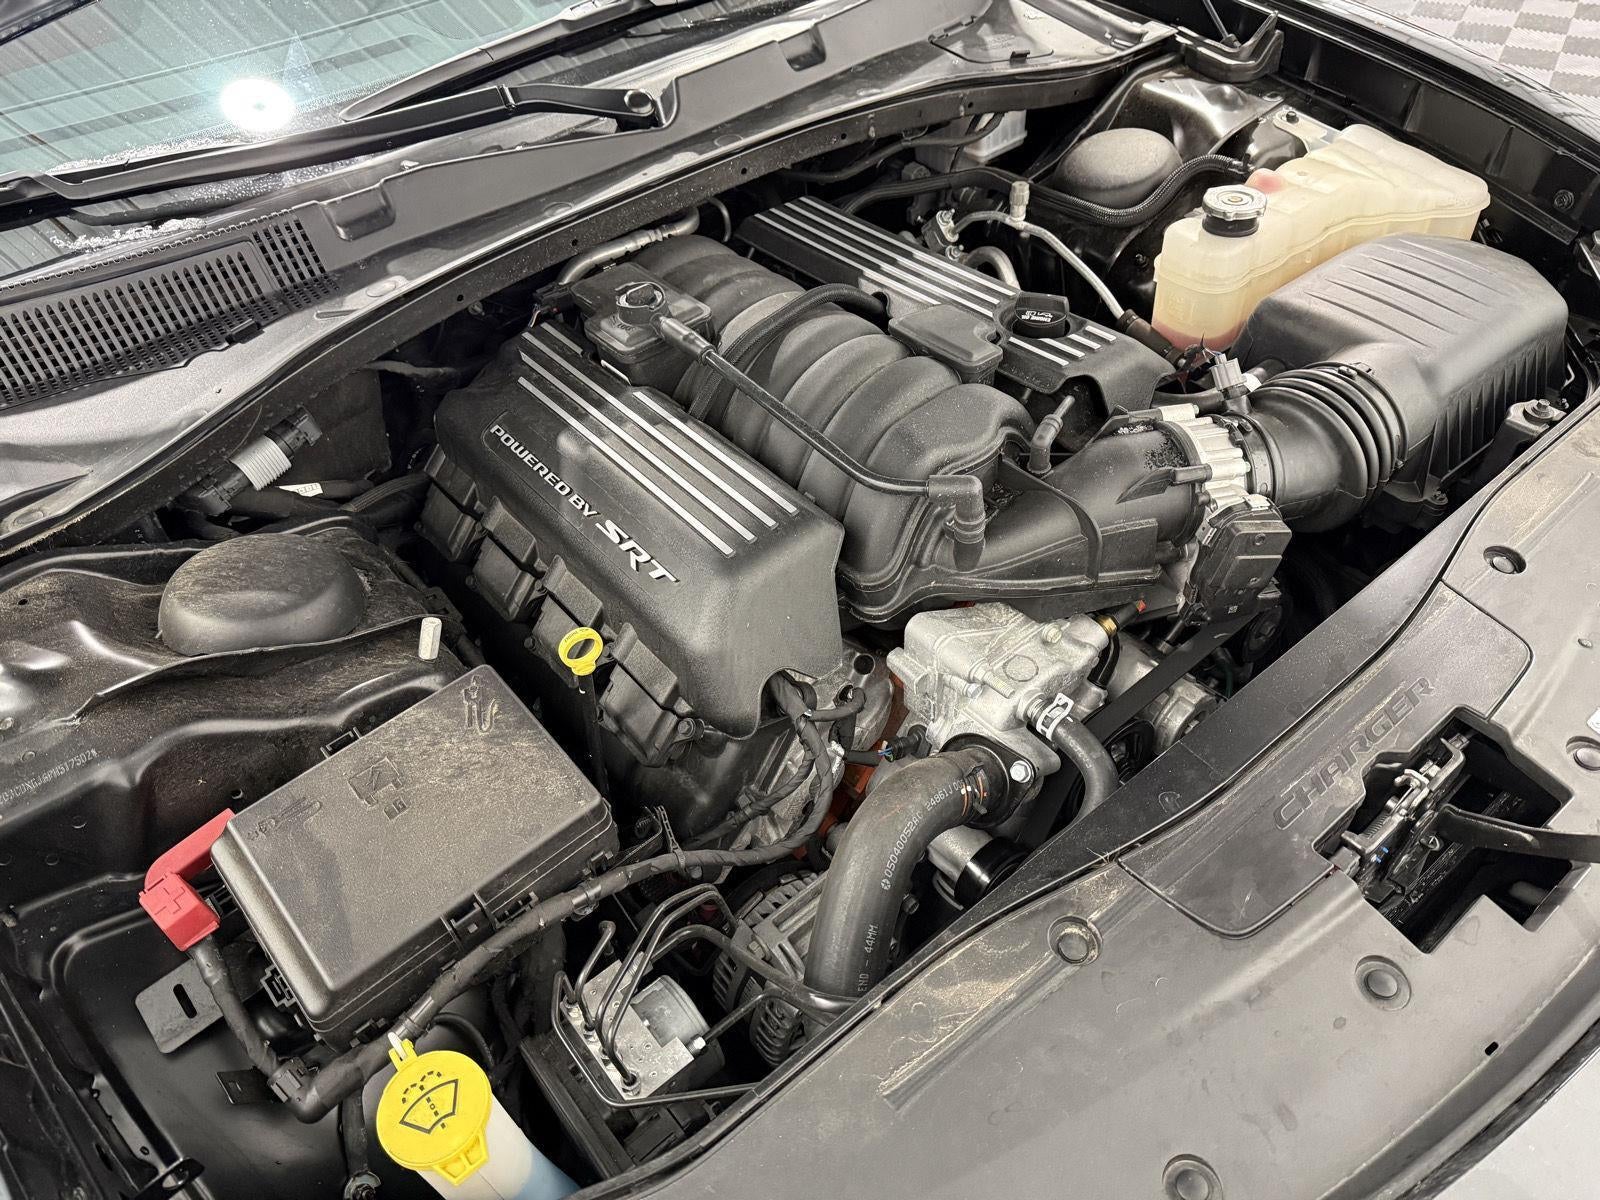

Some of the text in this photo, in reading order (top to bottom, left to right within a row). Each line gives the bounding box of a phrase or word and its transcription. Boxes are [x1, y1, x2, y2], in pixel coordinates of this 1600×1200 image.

[490, 424, 678, 583] POWERED BY SRT
[1273, 677, 1436, 830] CHARGER
[864, 923, 879, 954] 44MM
